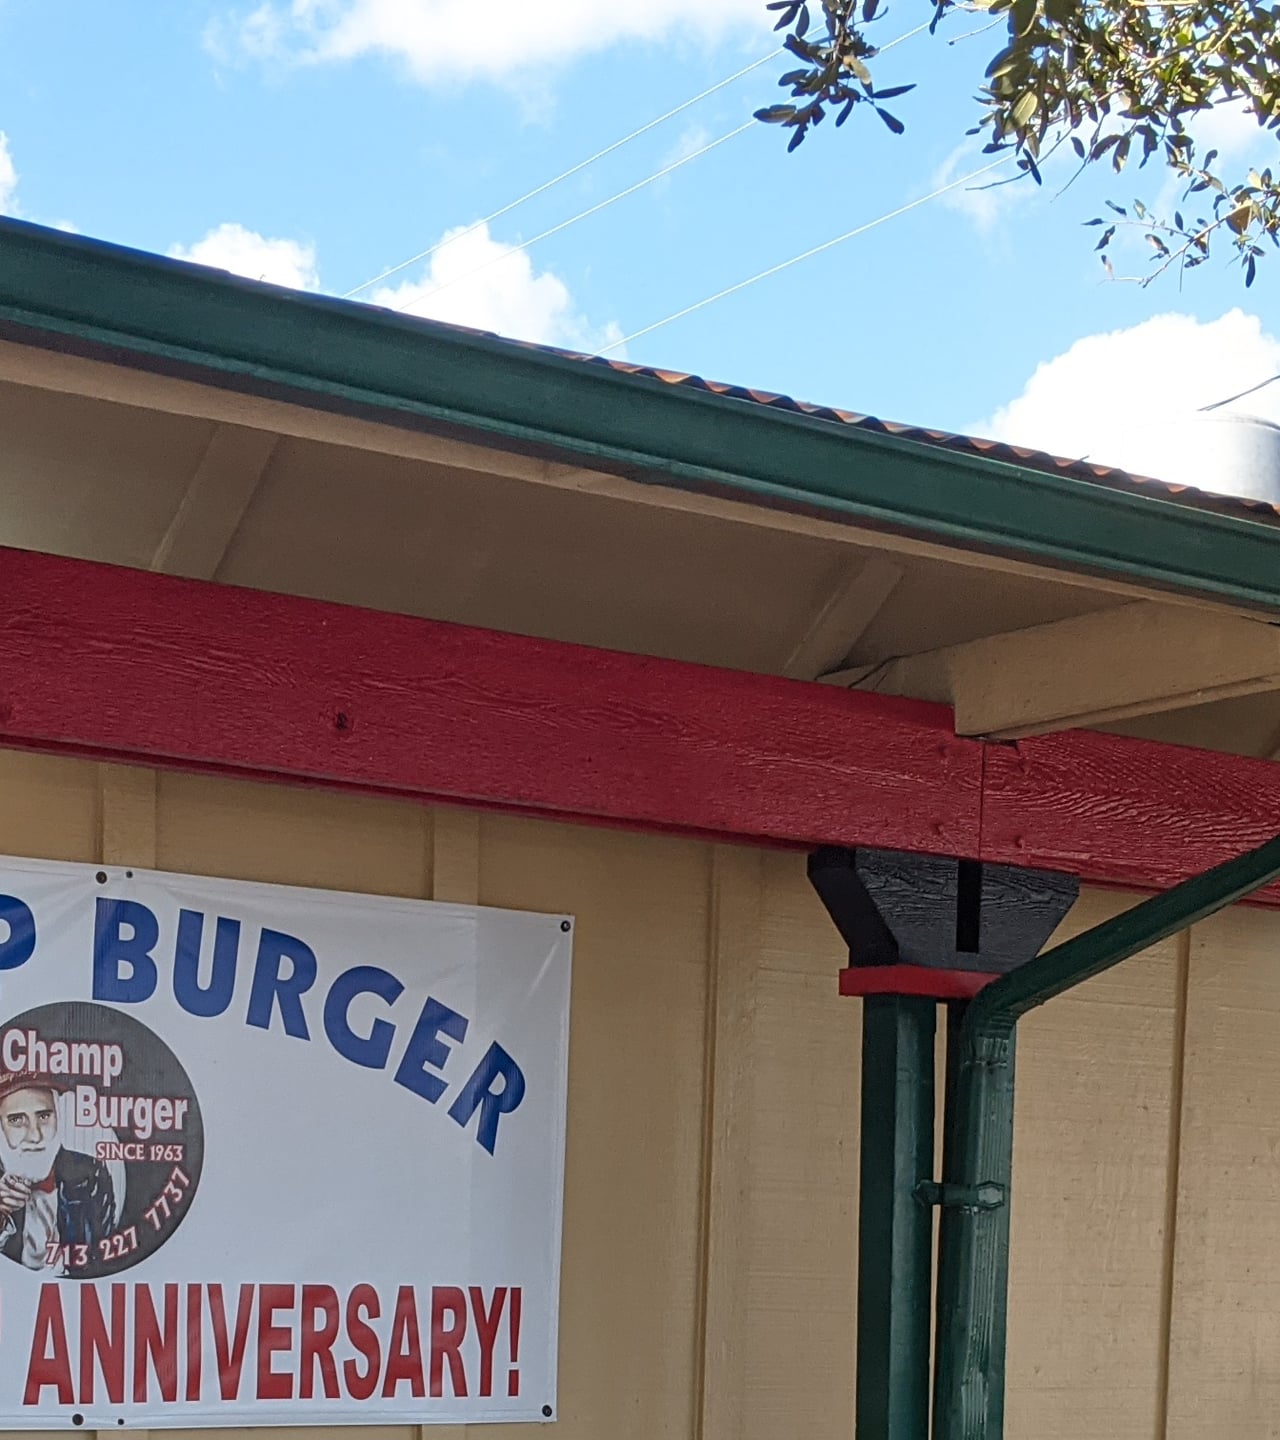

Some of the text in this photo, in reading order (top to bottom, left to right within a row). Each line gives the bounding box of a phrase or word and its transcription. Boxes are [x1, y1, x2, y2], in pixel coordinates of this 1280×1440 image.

[2, 1028, 123, 1087] Champ
[93, 896, 526, 1156] BURGER
[75, 1085, 188, 1139] Burger
[96, 1143, 184, 1162] SINCE 1963
[45, 1165, 193, 1266] 713 227 7737
[23, 1284, 522, 1407] ANNIVERSARY!
